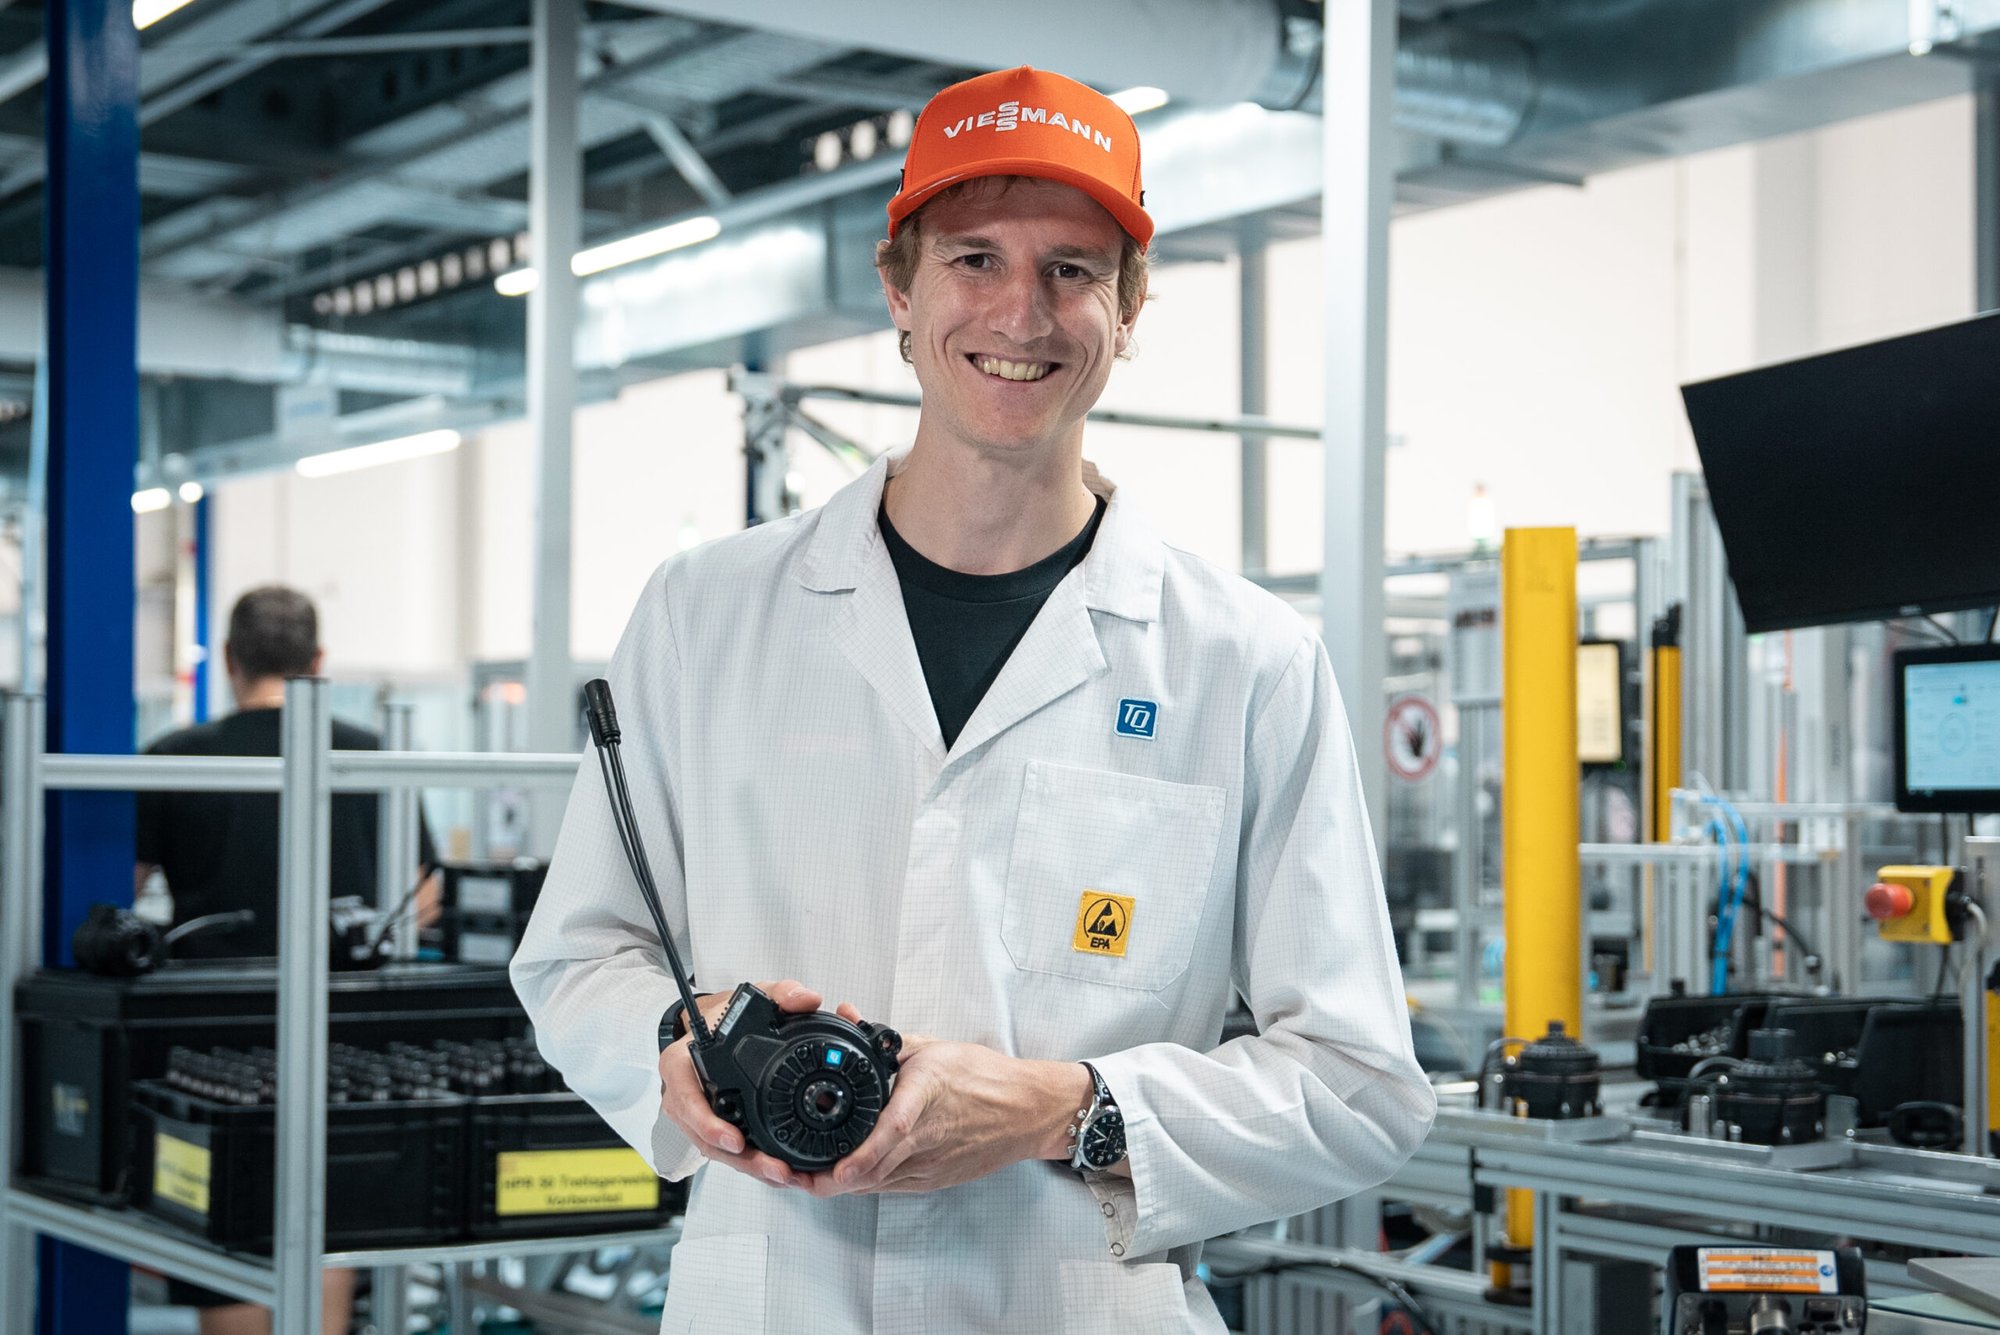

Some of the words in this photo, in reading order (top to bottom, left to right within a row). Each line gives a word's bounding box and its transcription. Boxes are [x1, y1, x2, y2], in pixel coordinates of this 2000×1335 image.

[943, 100, 1112, 153] VIESSMANN
[1124, 703, 1151, 734] TQ
[1090, 936, 1110, 950] EPA
